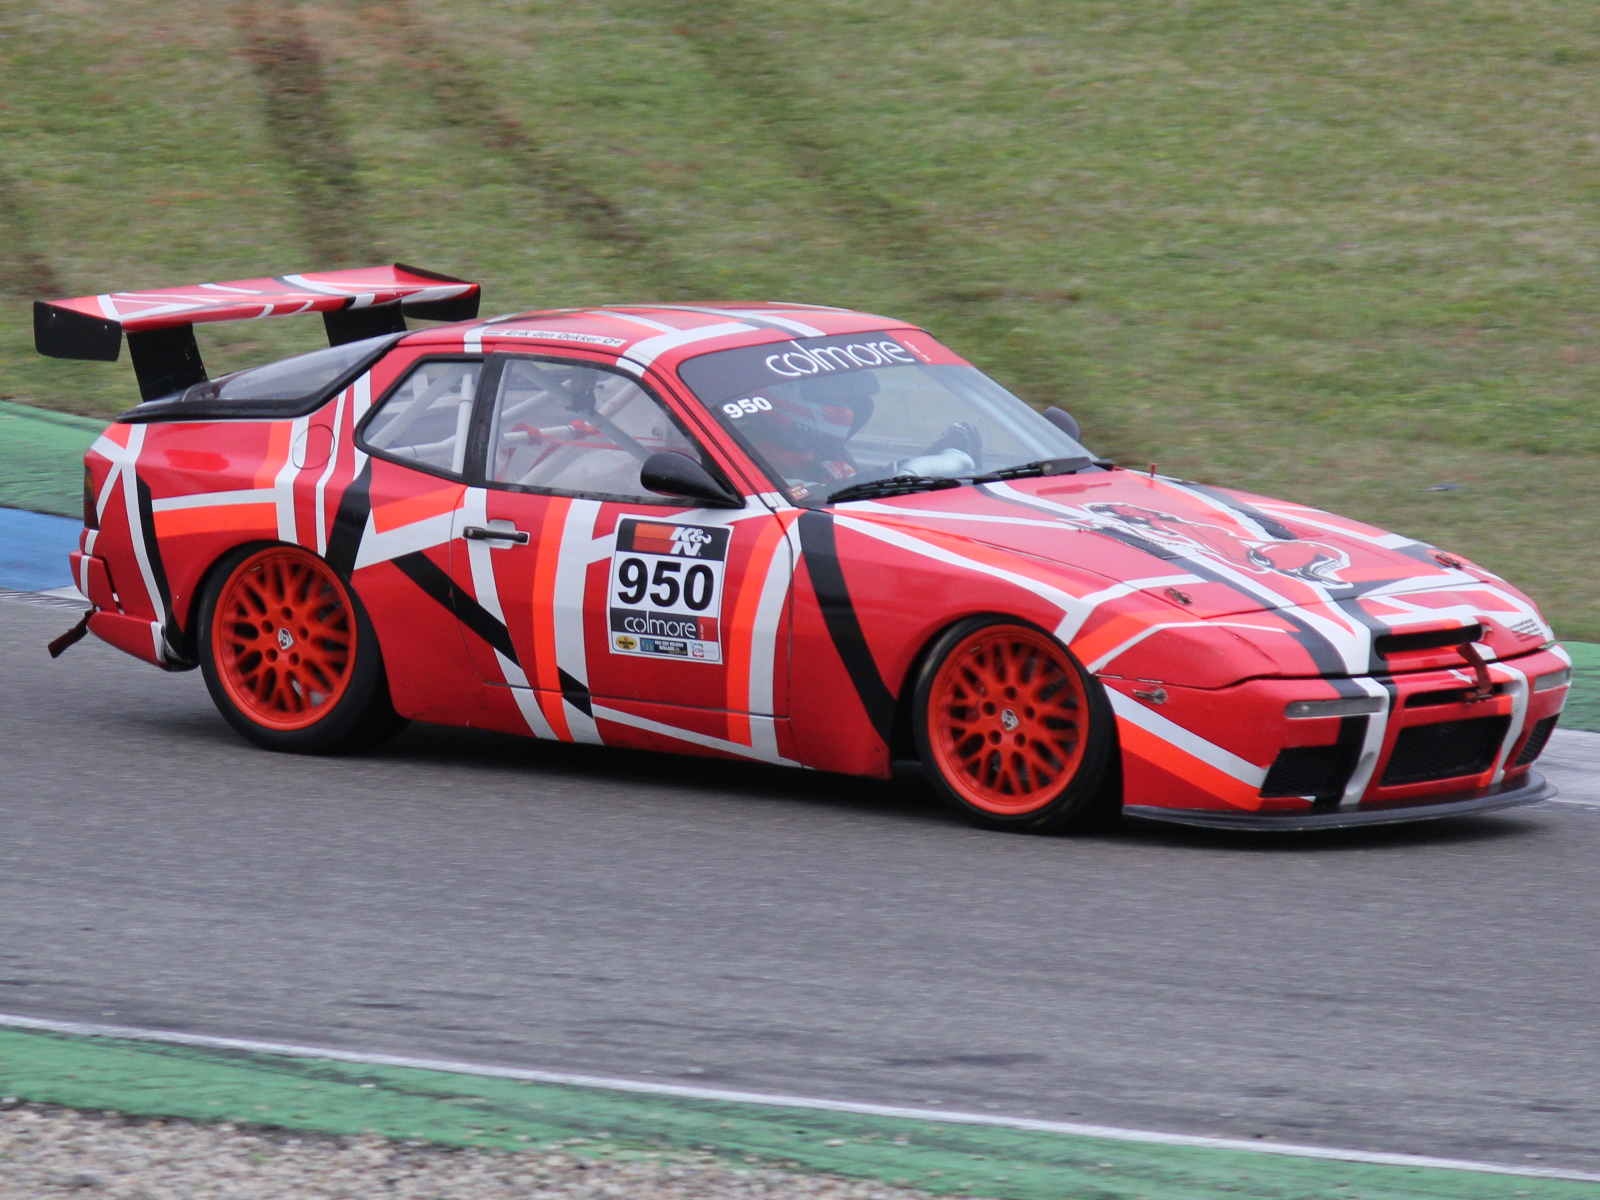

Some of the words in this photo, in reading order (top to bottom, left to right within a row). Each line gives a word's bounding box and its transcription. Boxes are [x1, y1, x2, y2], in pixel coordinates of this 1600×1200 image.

[558, 333, 601, 343] Dekker
[765, 340, 915, 377] colmore
[722, 396, 773, 419] 950
[617, 557, 715, 611] 950
[624, 610, 697, 638] colmore
